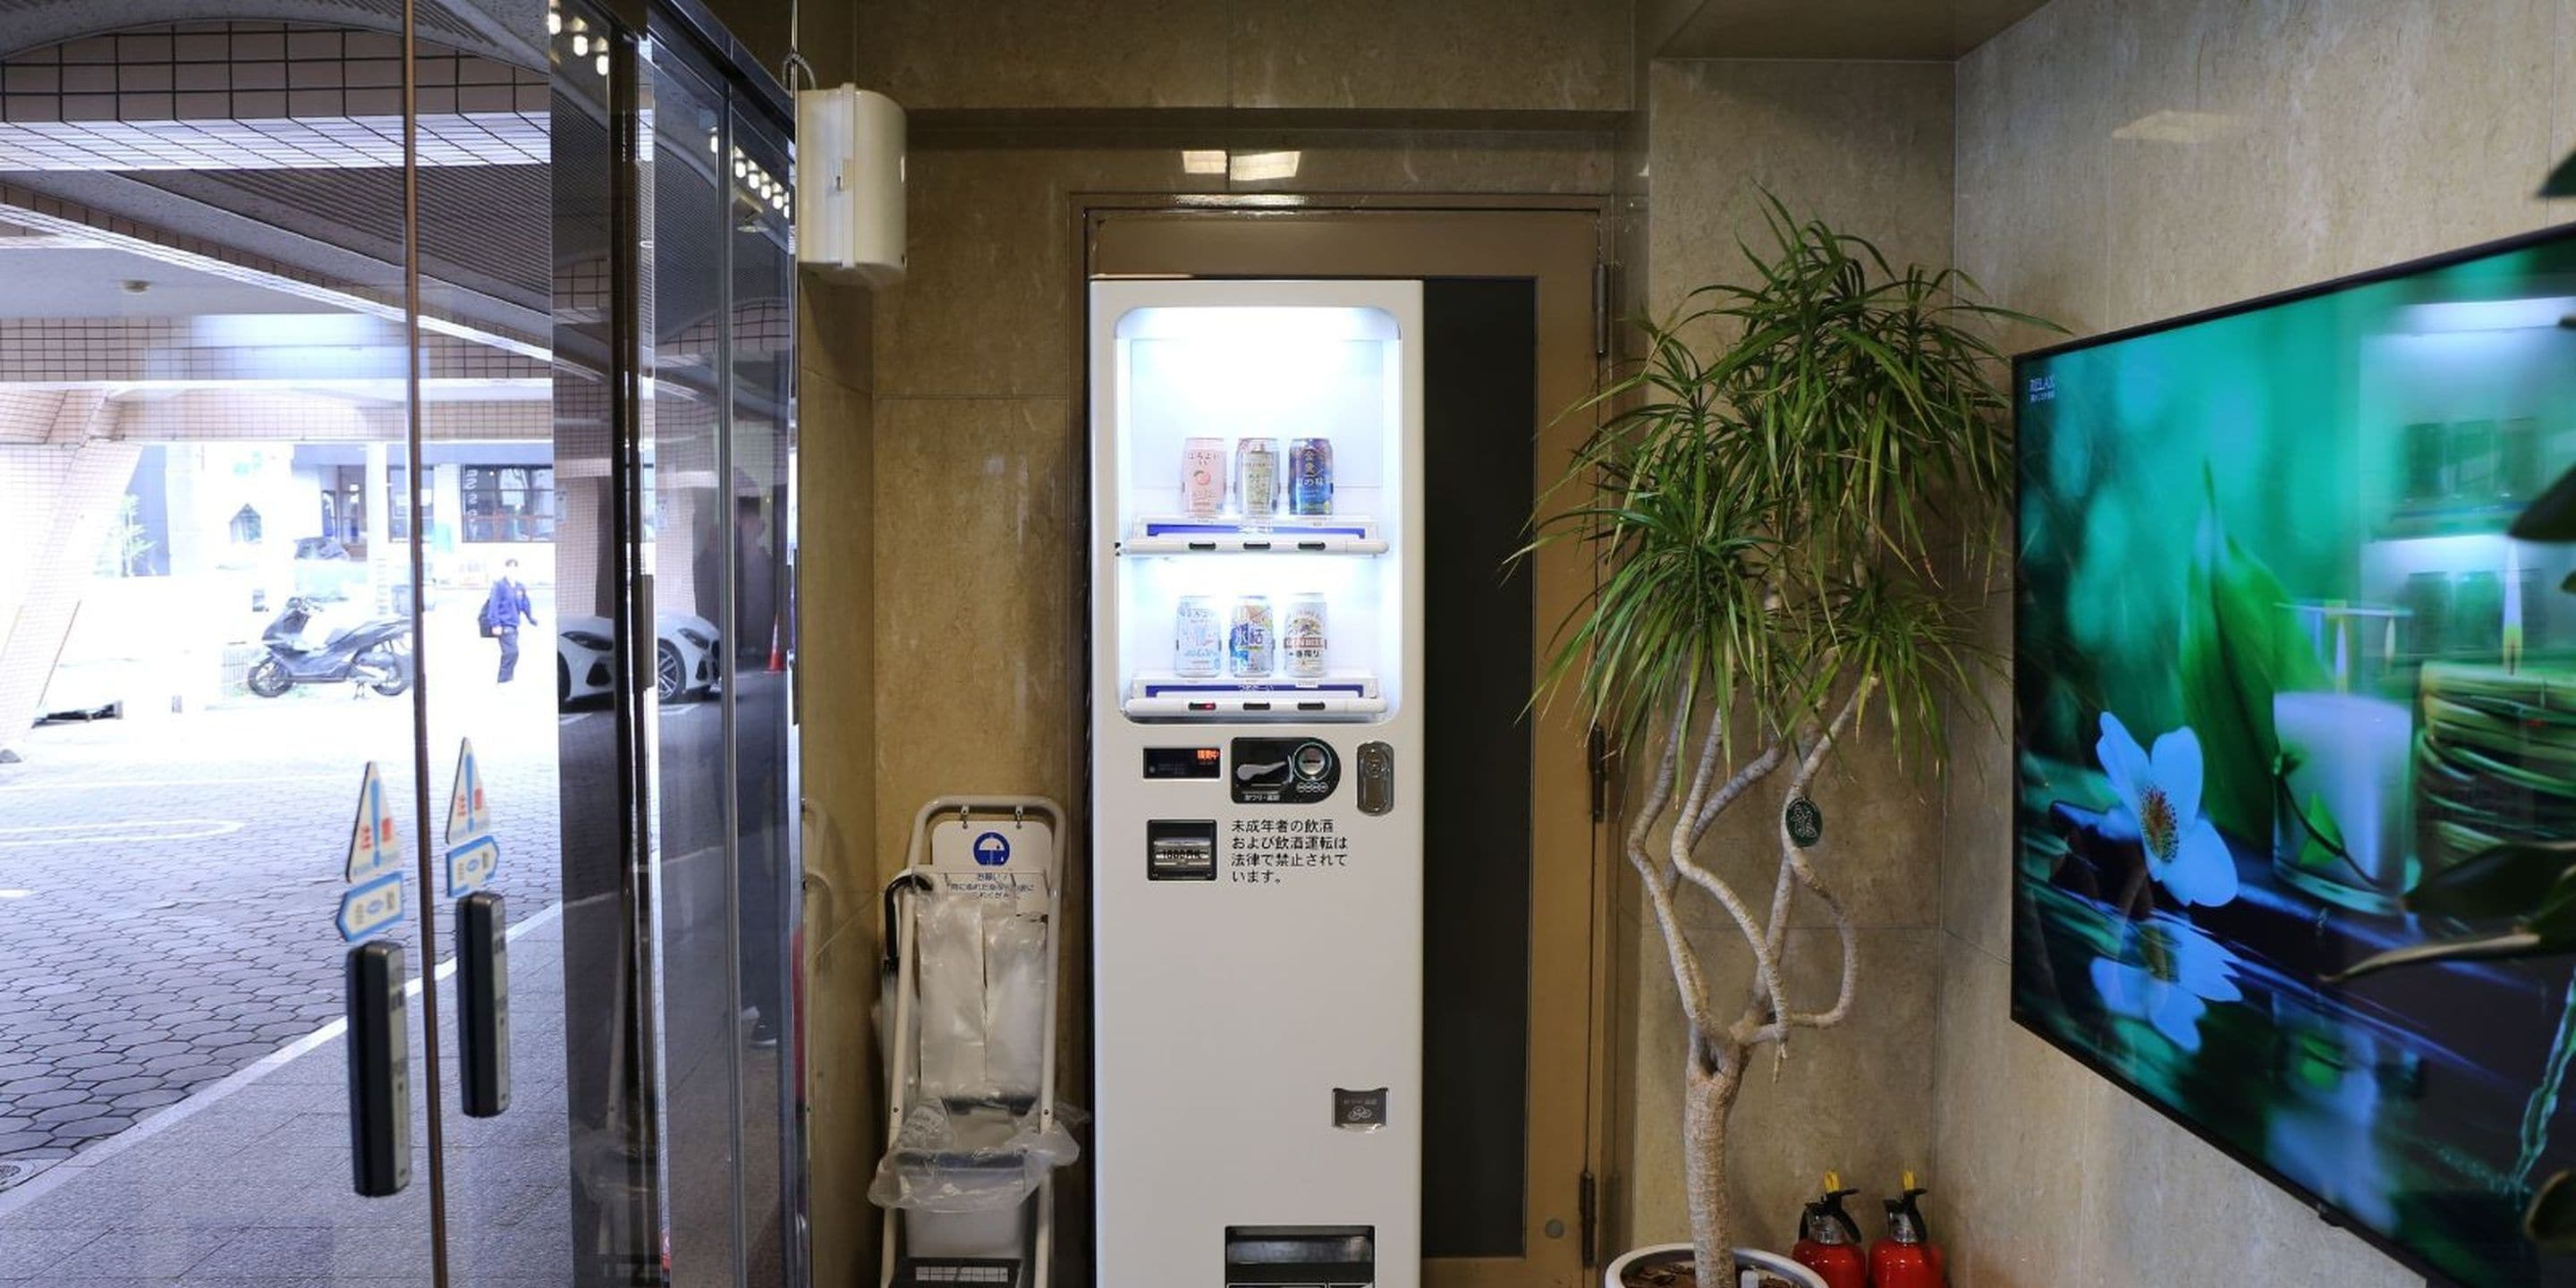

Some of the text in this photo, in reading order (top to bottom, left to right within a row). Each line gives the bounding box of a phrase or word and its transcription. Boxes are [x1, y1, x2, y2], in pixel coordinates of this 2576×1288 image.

[1234, 623, 1264, 645] 氷結
[1232, 818, 1334, 833] 未成年者の飲酒
[1232, 835, 1348, 851] および飲酒運転は
[1231, 852, 1348, 867] 法律で禁止されて
[1232, 869, 1281, 884] います。
